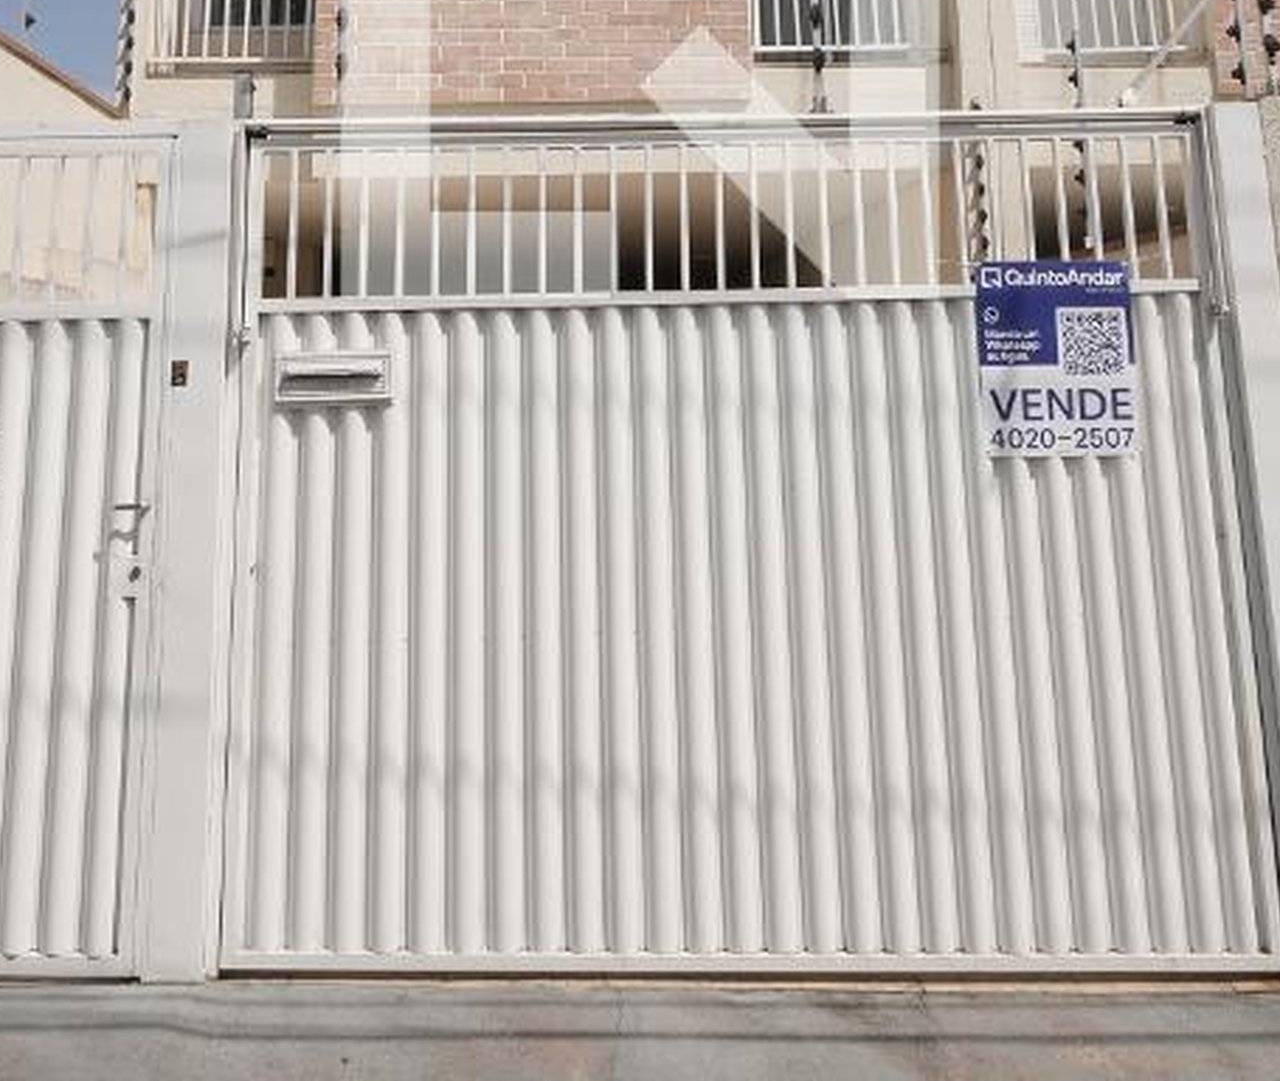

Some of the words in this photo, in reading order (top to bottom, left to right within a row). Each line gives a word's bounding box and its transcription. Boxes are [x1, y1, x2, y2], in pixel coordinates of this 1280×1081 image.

[1004, 267, 1124, 287] QuintoAndar
[990, 388, 1135, 421] VENDE
[991, 427, 1135, 449] 4020-2507
